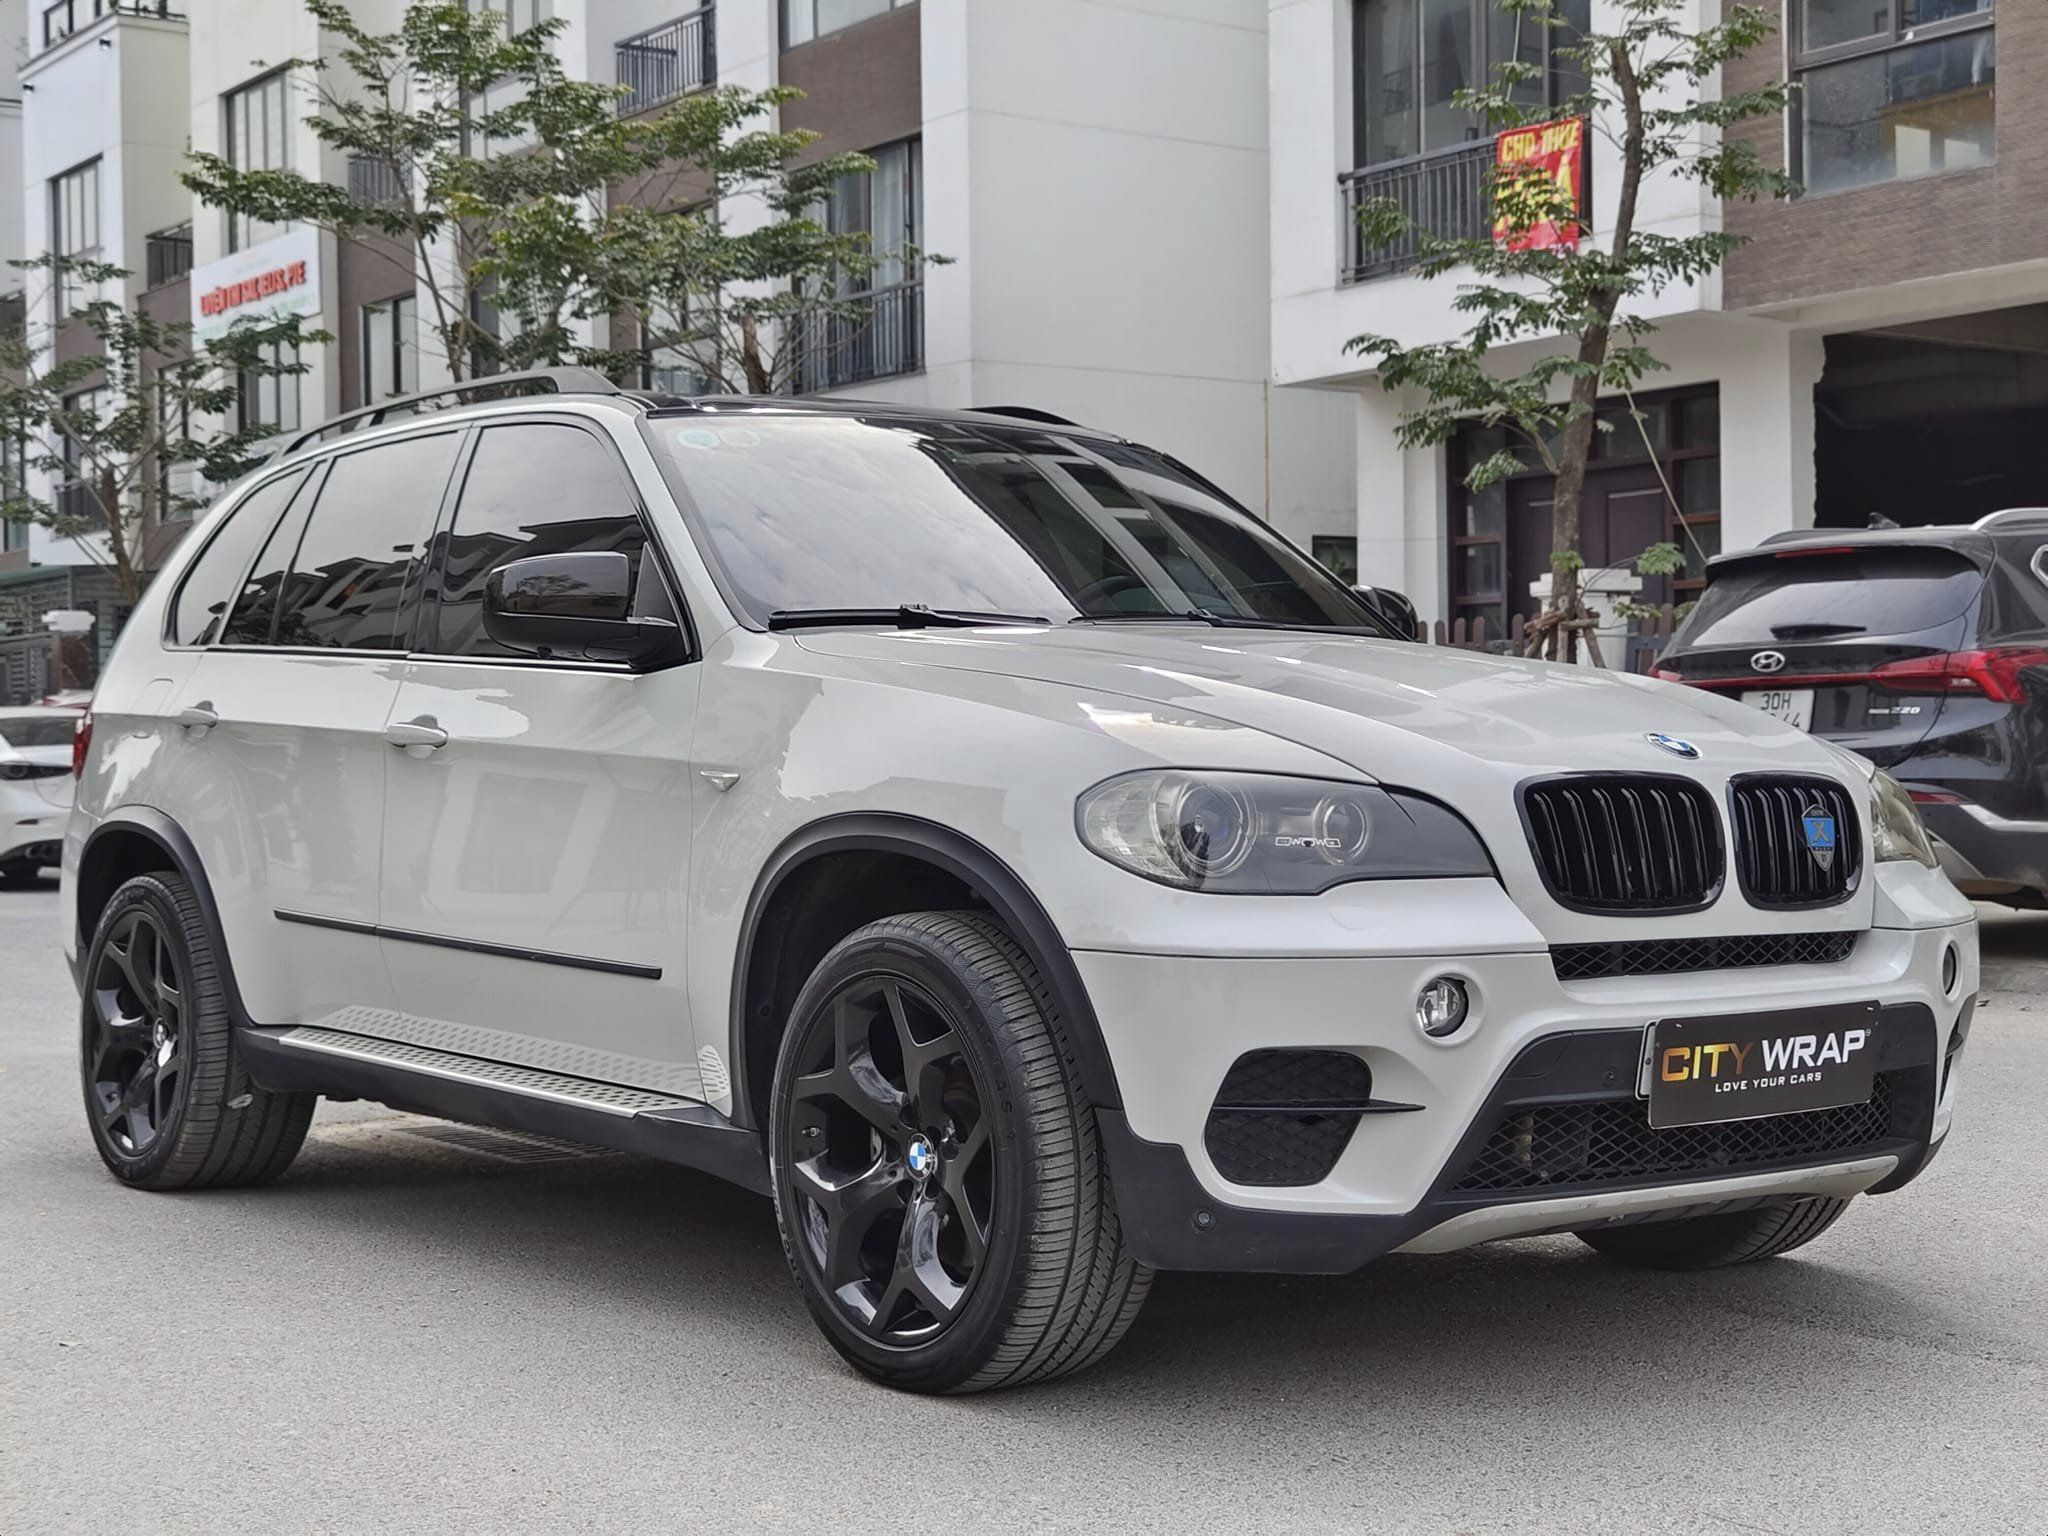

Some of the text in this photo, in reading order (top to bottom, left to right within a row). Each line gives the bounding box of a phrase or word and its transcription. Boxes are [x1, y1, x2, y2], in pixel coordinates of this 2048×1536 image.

[1502, 131, 1536, 162] CHO
[1760, 692, 1792, 711] 30H
[1661, 1041, 1754, 1082] CITY
[1714, 1071, 1823, 1093] LOVE YOUR CARS
